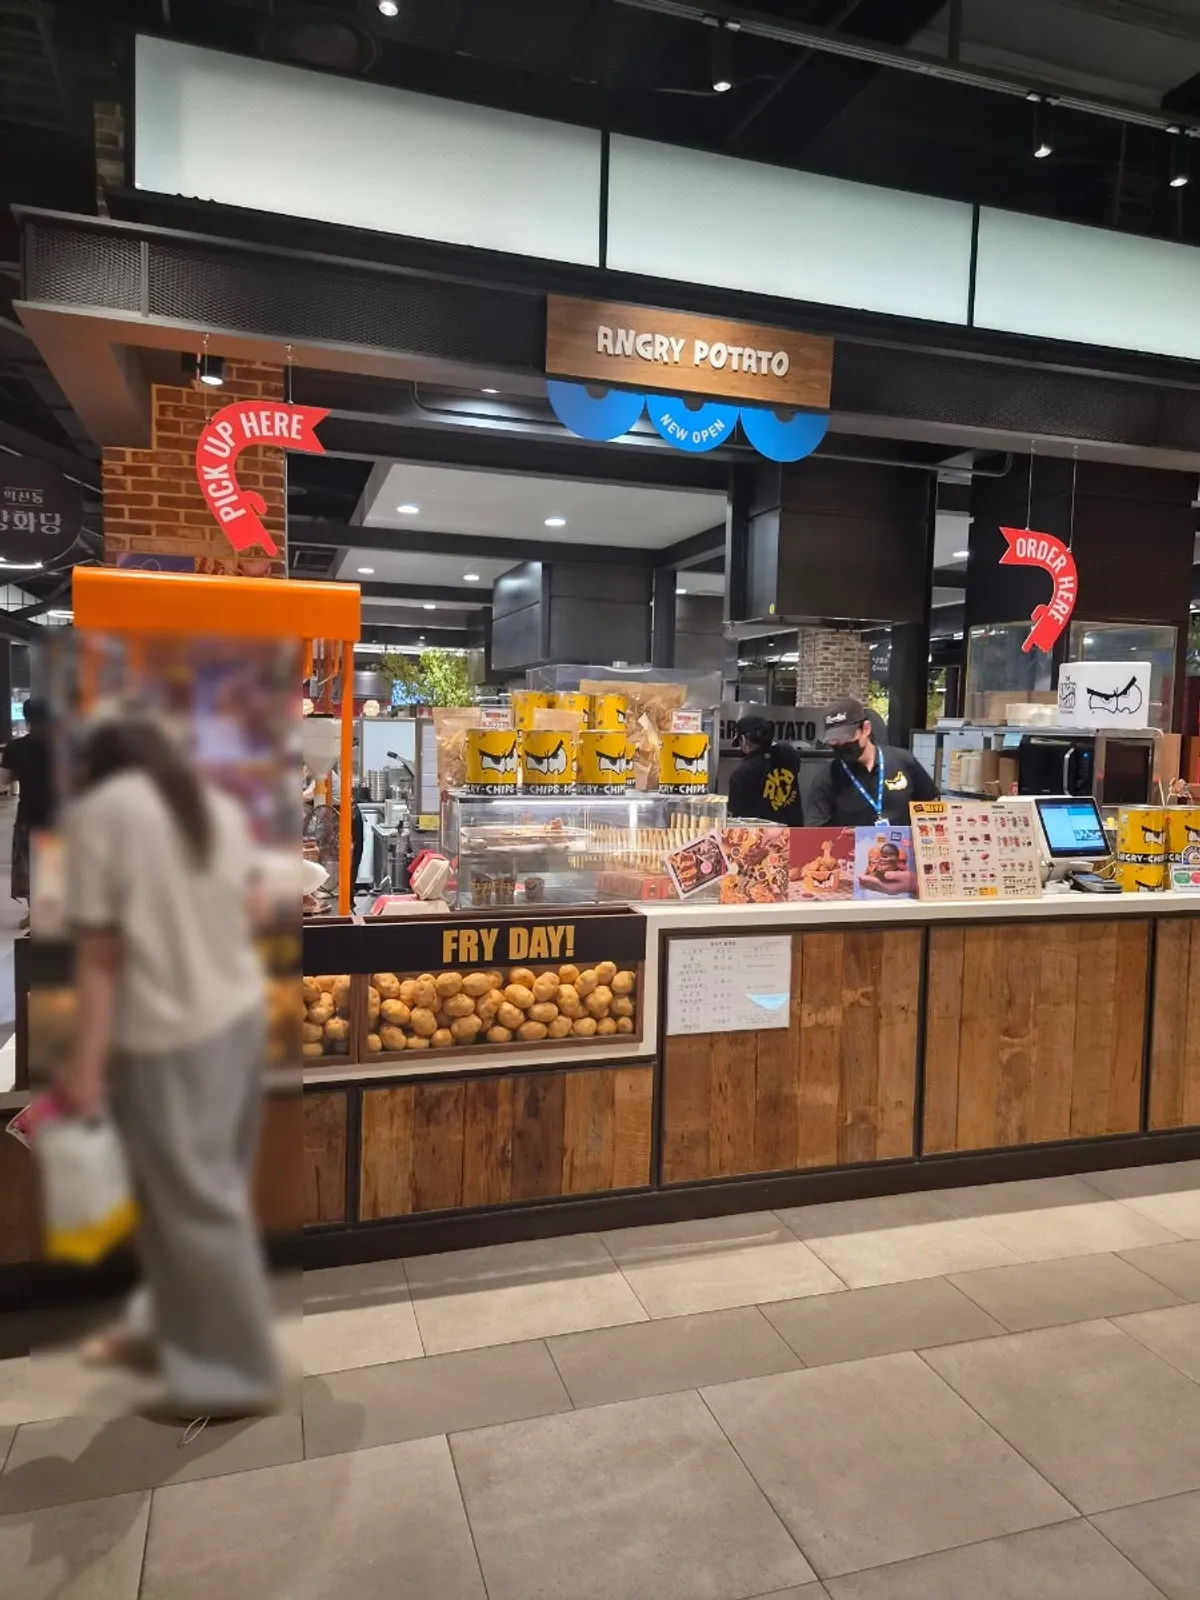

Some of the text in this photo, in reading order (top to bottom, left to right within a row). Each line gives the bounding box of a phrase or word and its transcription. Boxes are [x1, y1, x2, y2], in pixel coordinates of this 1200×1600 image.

[597, 325, 790, 377] ANGRY POTATO
[659, 413, 727, 444] NEW OPEN
[201, 411, 304, 523] PICK UP HERE
[1016, 537, 1075, 625] ORDER HERE
[442, 925, 575, 963] FRY DAY!
